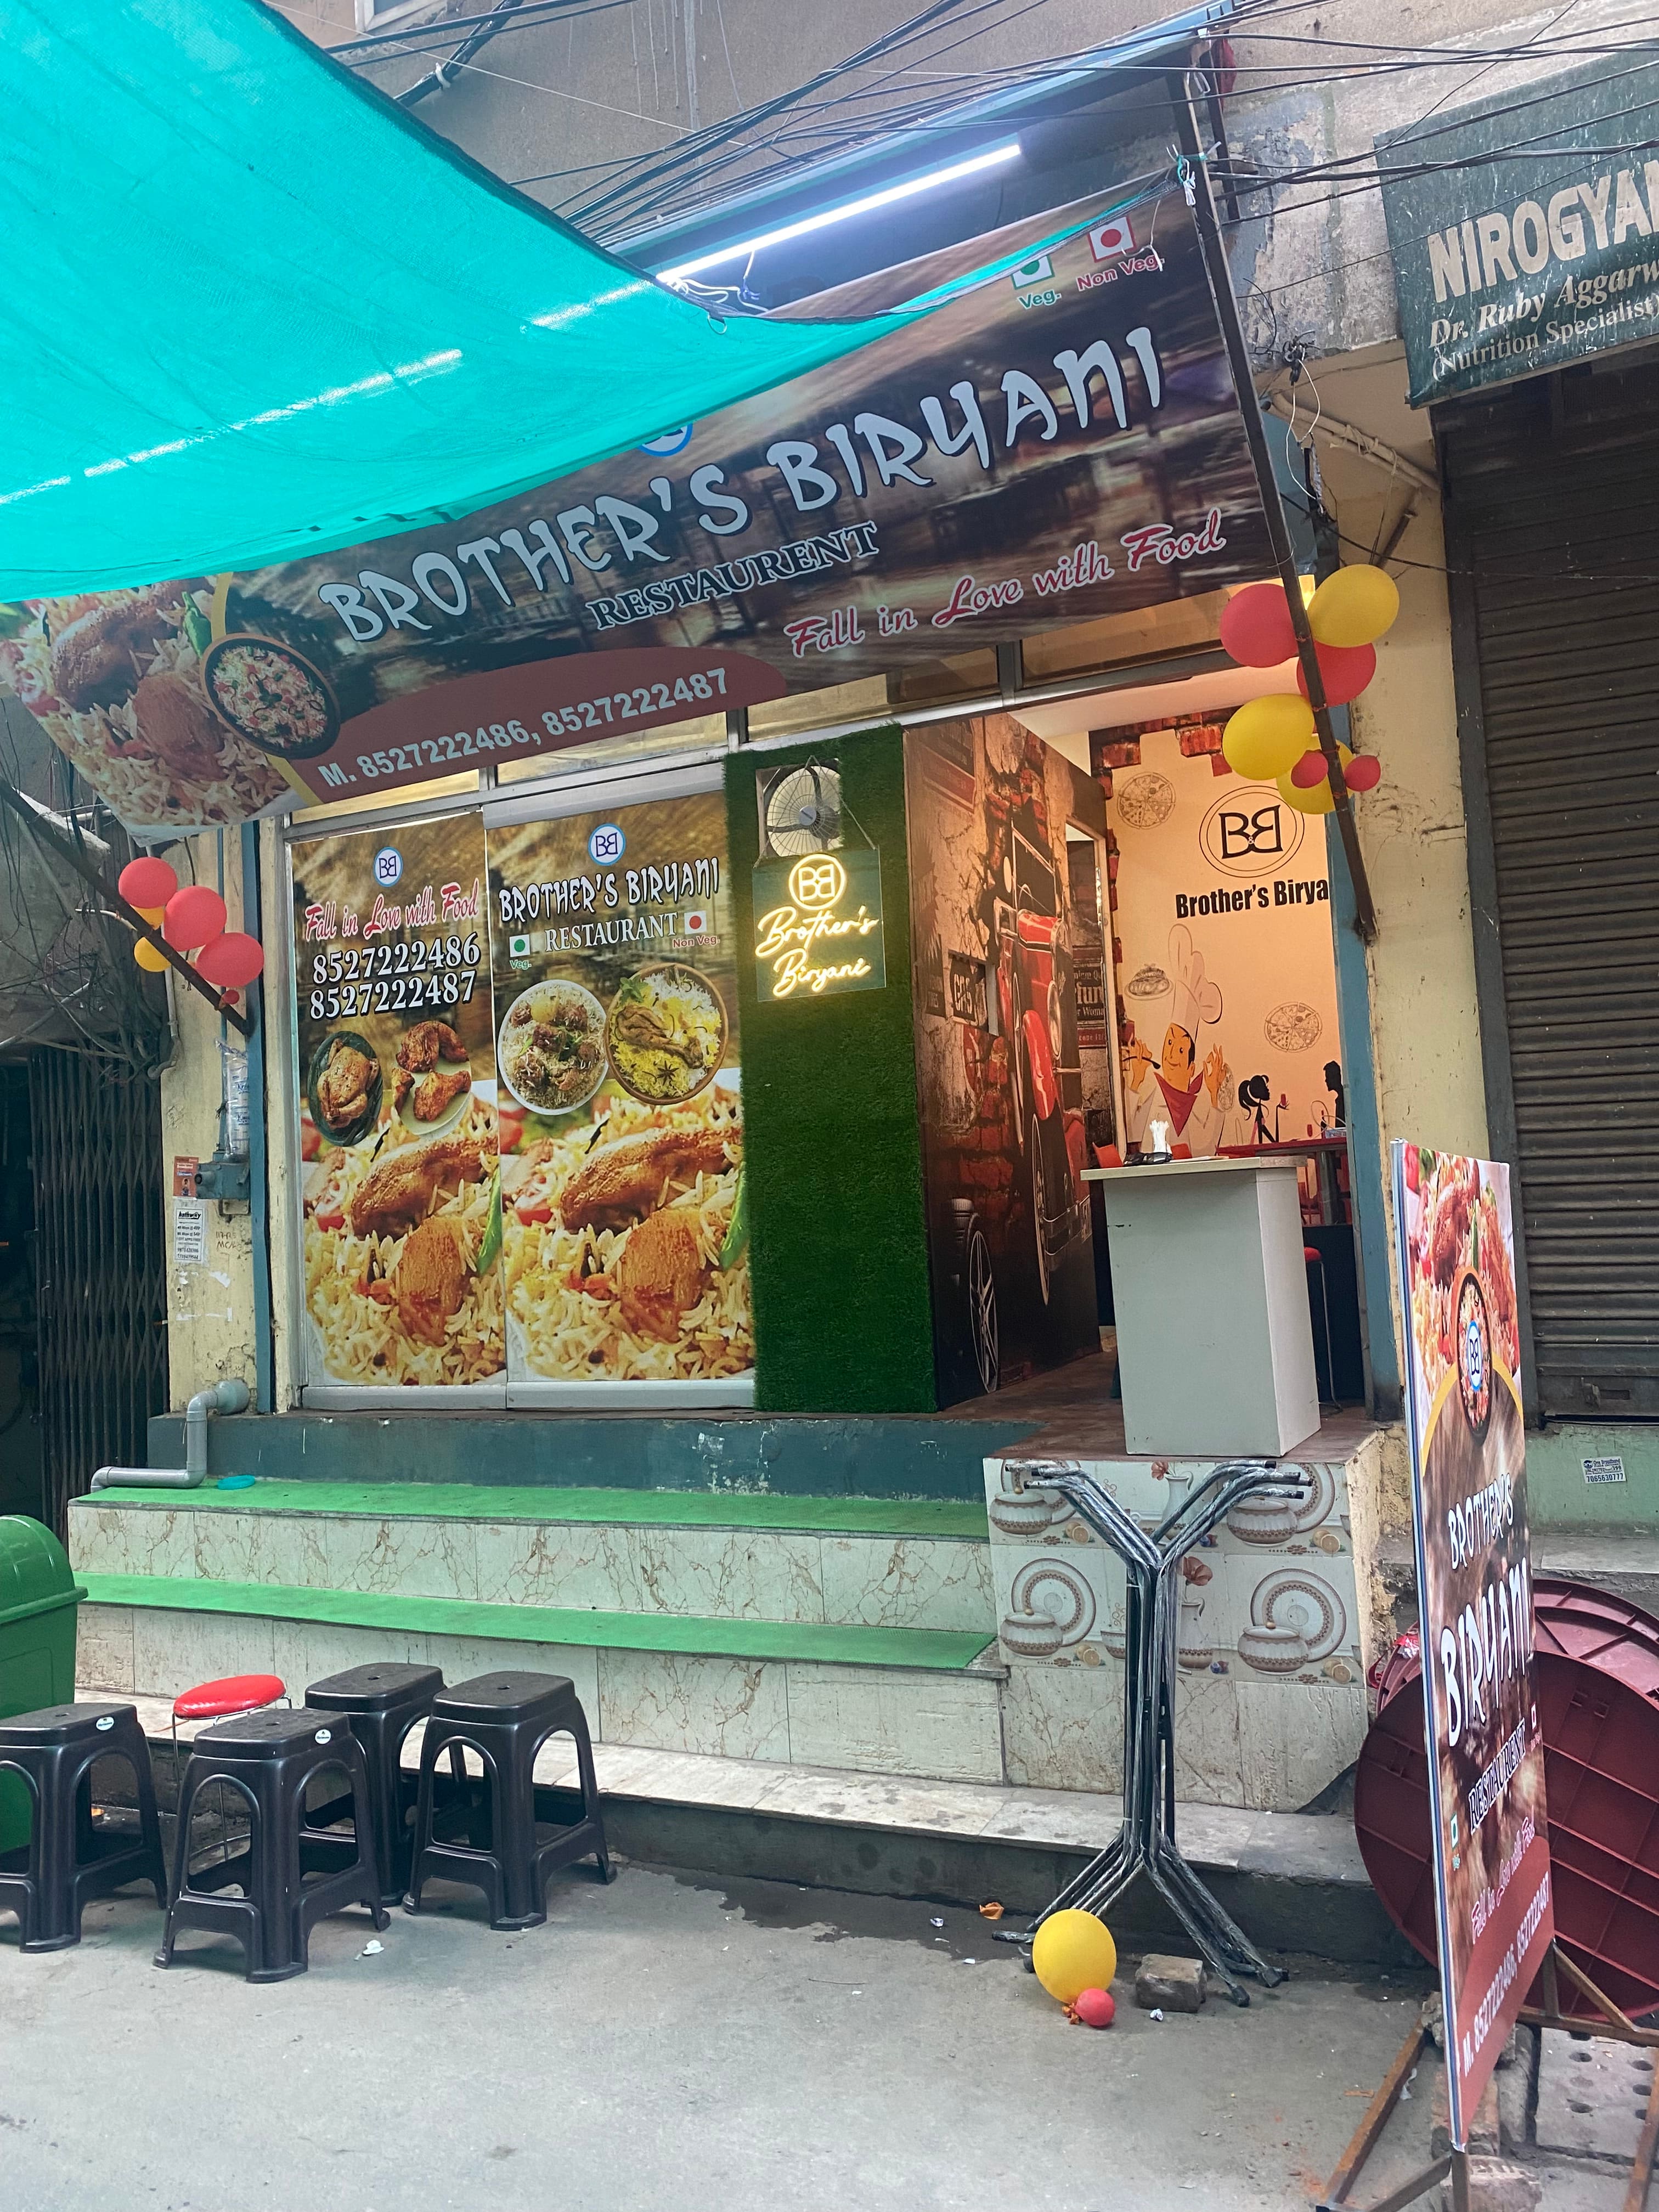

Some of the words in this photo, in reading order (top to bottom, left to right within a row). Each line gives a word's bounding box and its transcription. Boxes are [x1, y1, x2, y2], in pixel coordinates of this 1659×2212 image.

[1018, 289, 1062, 310] Veg.
[1076, 269, 1118, 291] Non
[1118, 255, 1165, 276] Veg.
[1429, 319, 1469, 348] Dr.
[1477, 291, 1546, 333] Ruby
[1432, 331, 1540, 383] (Nutrition
[318, 464, 753, 642] BROTHER'S
[766, 326, 1166, 511] BIRYANI
[585, 521, 880, 631] RESTAURENT
[784, 606, 864, 658] Fall
[878, 606, 918, 637] in
[932, 574, 1024, 628] Love
[1032, 546, 1115, 594] with
[1120, 506, 1227, 572] Food
[317, 763, 356, 788] M.
[356, 718, 542, 780] 8527222486,
[542, 667, 729, 736] 8527222487
[305, 901, 337, 942] Fall
[342, 905, 358, 939] in
[363, 893, 401, 940] Love
[405, 885, 437, 928] with
[441, 878, 479, 922] Food
[499, 873, 619, 923] BROTHER'S
[625, 857, 719, 905] BIRYANI
[1175, 884, 1270, 919] Brother's
[1274, 878, 1329, 907] Birya
[544, 912, 678, 952] RESTAURANT
[672, 937, 695, 949] Non
[696, 935, 721, 946] Veg.
[755, 905, 879, 957] Brother's
[313, 932, 482, 986] 8527222486
[509, 960, 532, 970] Veg.
[772, 948, 872, 997] Biryani
[310, 970, 477, 1020] 8527222487
[1448, 1473, 1514, 1571] BROTHER'S
[1441, 1557, 1531, 1747] BIRYANI
[1469, 1717, 1526, 1836] RESTAURENT
[1471, 1888, 1487, 1945] Fall
[1521, 1804, 1536, 1854] Food
